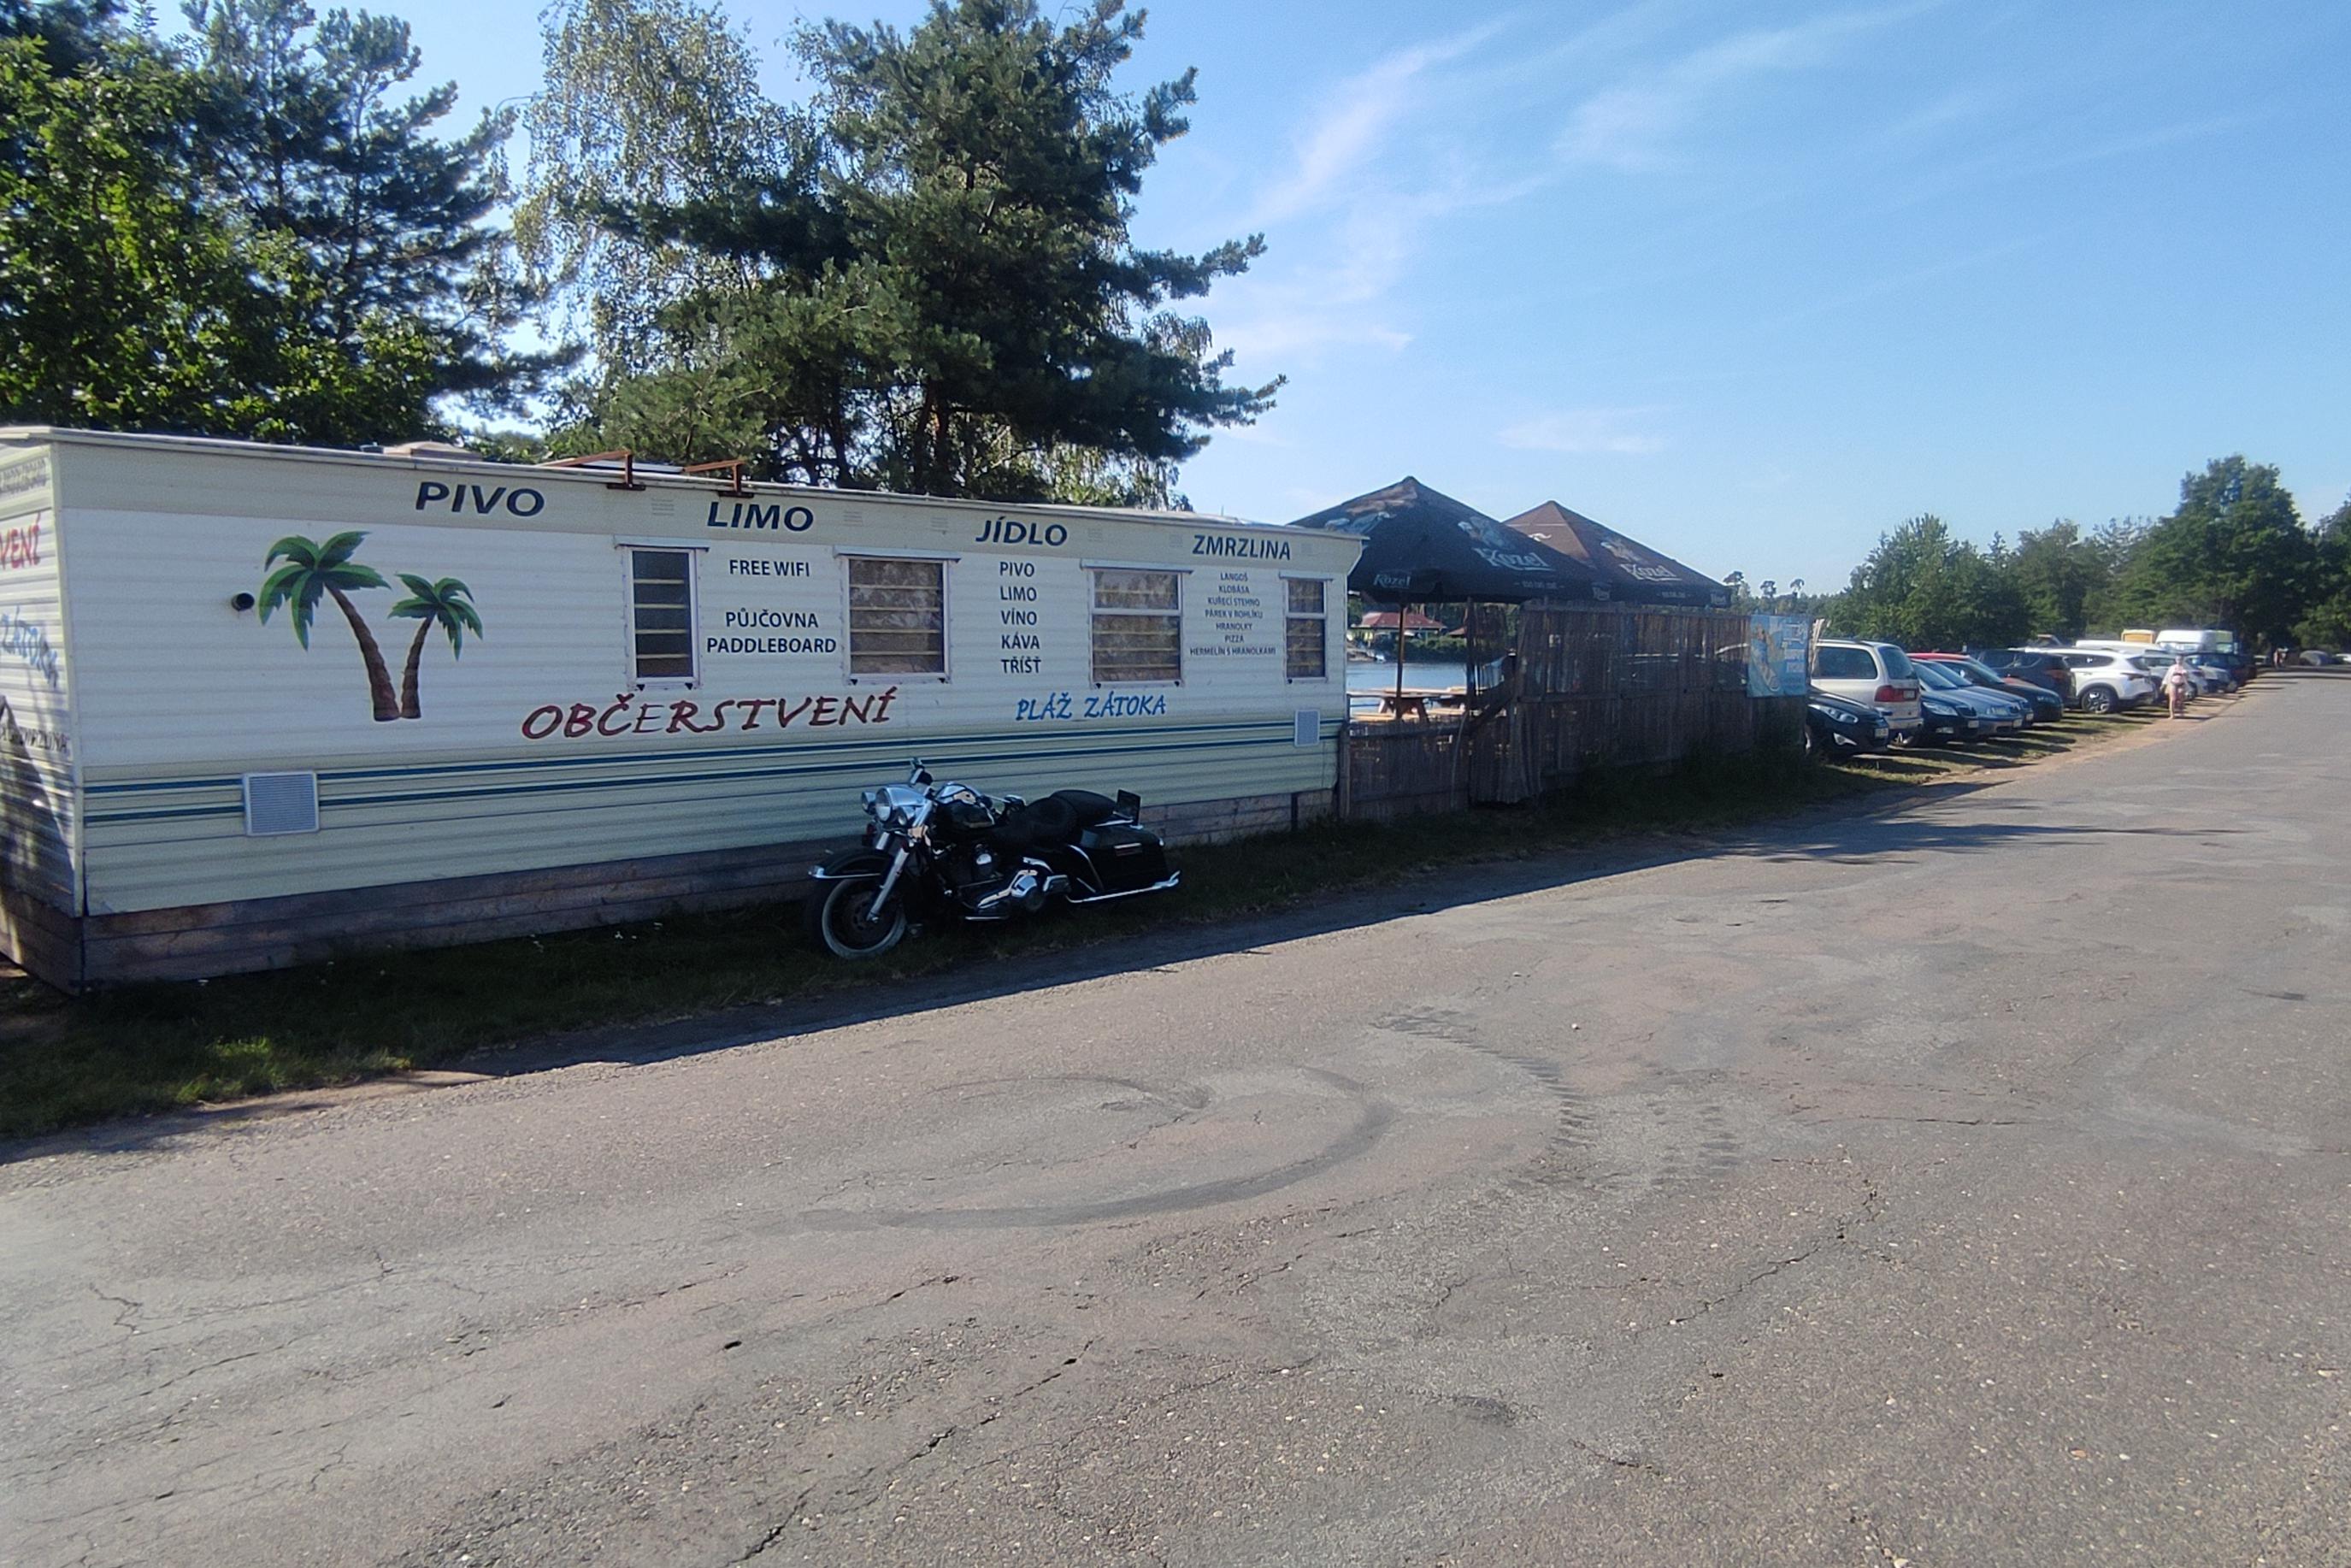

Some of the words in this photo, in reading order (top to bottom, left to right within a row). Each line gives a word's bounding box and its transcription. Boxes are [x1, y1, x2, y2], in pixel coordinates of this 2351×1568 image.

[415, 481, 545, 516] PIVO
[707, 501, 814, 532] LIMO
[975, 516, 1068, 547] JÍDLO
[1192, 534, 1291, 561] ZMRZLINA
[729, 559, 770, 575] FREE
[774, 561, 810, 577] WIFI
[999, 562, 1035, 577] PIVO
[1220, 572, 1248, 581] LANGOŠ
[1000, 586, 1037, 602] LIMO
[1218, 585, 1250, 593] KLOBÁSA
[1234, 598, 1260, 607] STEHNO
[725, 608, 819, 628] PŮJČOVNA
[1001, 607, 1037, 625] VÍNO
[1205, 609, 1227, 617] PÁREK
[706, 638, 837, 653] PADDLEBOARD
[1001, 631, 1040, 650] KÁVA
[1224, 634, 1245, 643] PIZZA
[1001, 656, 1041, 674] TŘÍŠŤ
[521, 687, 898, 740] OBČERSTVENÍ
[1016, 692, 1072, 721] PLÁŽ
[1083, 690, 1167, 718] ZÁTOKA
